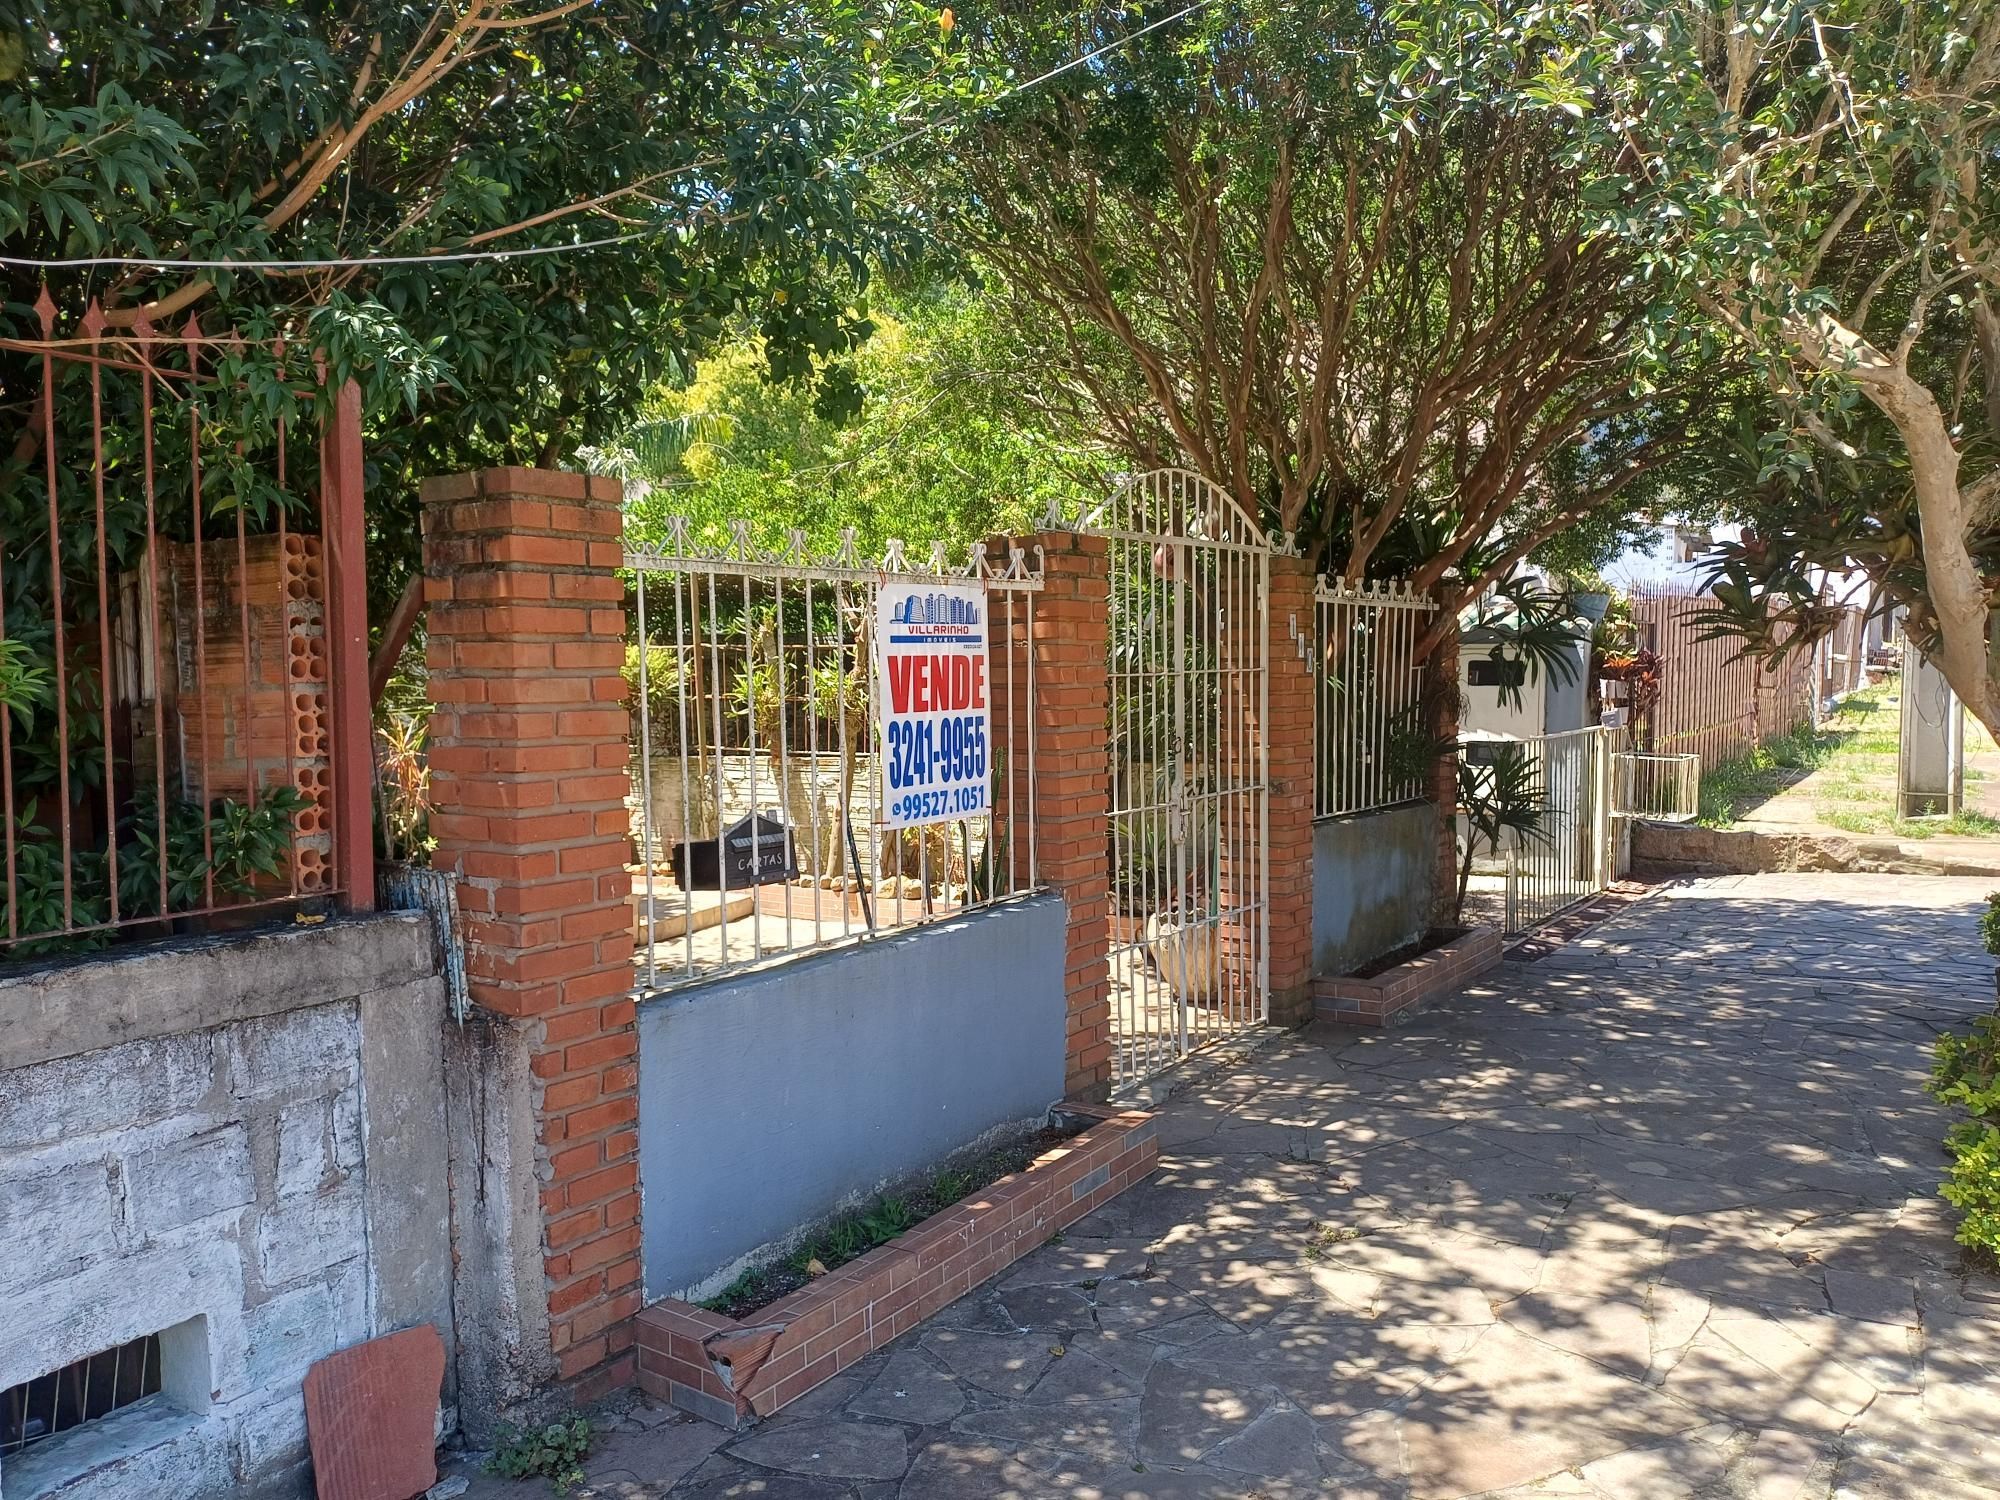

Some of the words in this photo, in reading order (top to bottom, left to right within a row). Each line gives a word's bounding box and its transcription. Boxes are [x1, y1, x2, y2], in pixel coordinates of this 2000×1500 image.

[908, 625, 969, 634] VILLARINHO
[887, 655, 985, 714] VENDE
[888, 716, 985, 789] 3241-9955
[903, 785, 985, 820] 99527.1051
[738, 852, 783, 871] CARTAS
